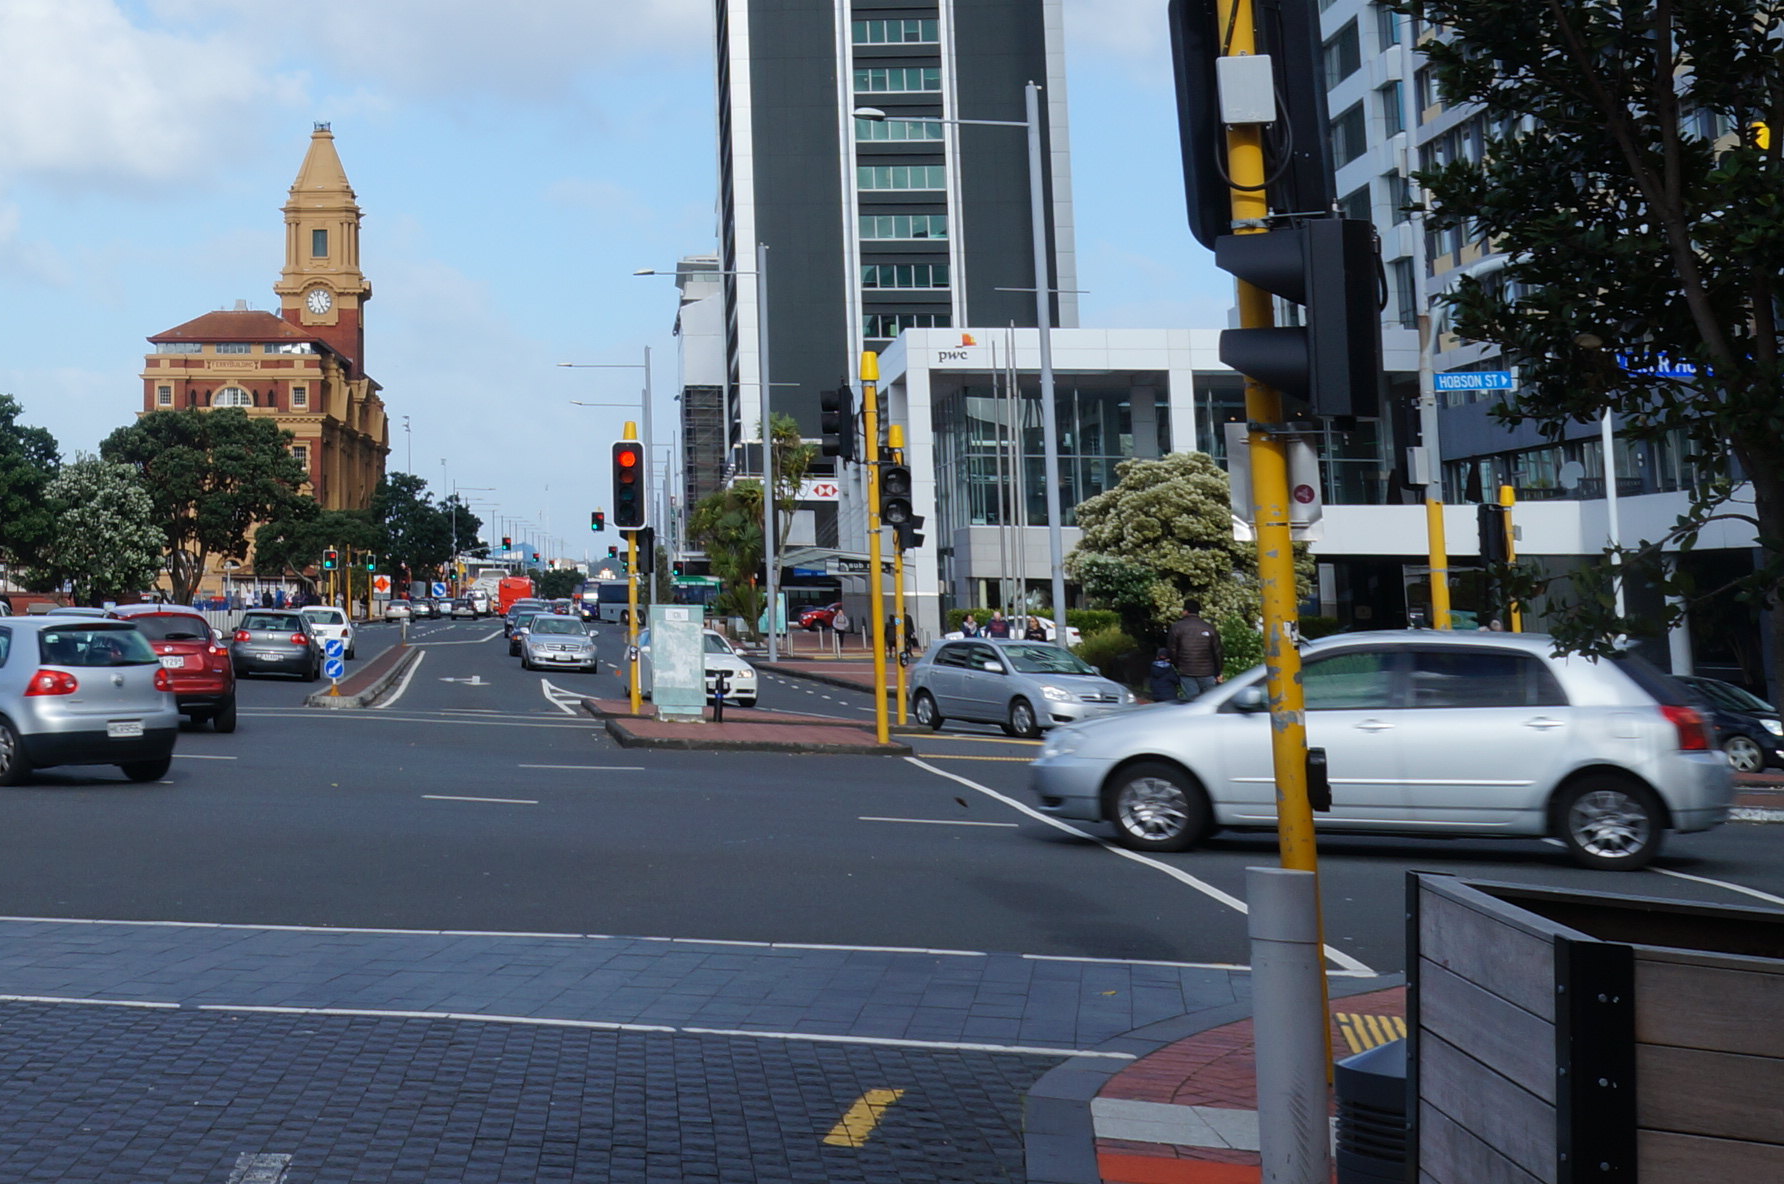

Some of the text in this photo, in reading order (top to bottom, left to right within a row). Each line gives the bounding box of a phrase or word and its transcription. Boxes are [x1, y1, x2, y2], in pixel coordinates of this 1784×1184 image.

[938, 351, 968, 363] pwc
[1438, 374, 1498, 388] HOBSON ST
